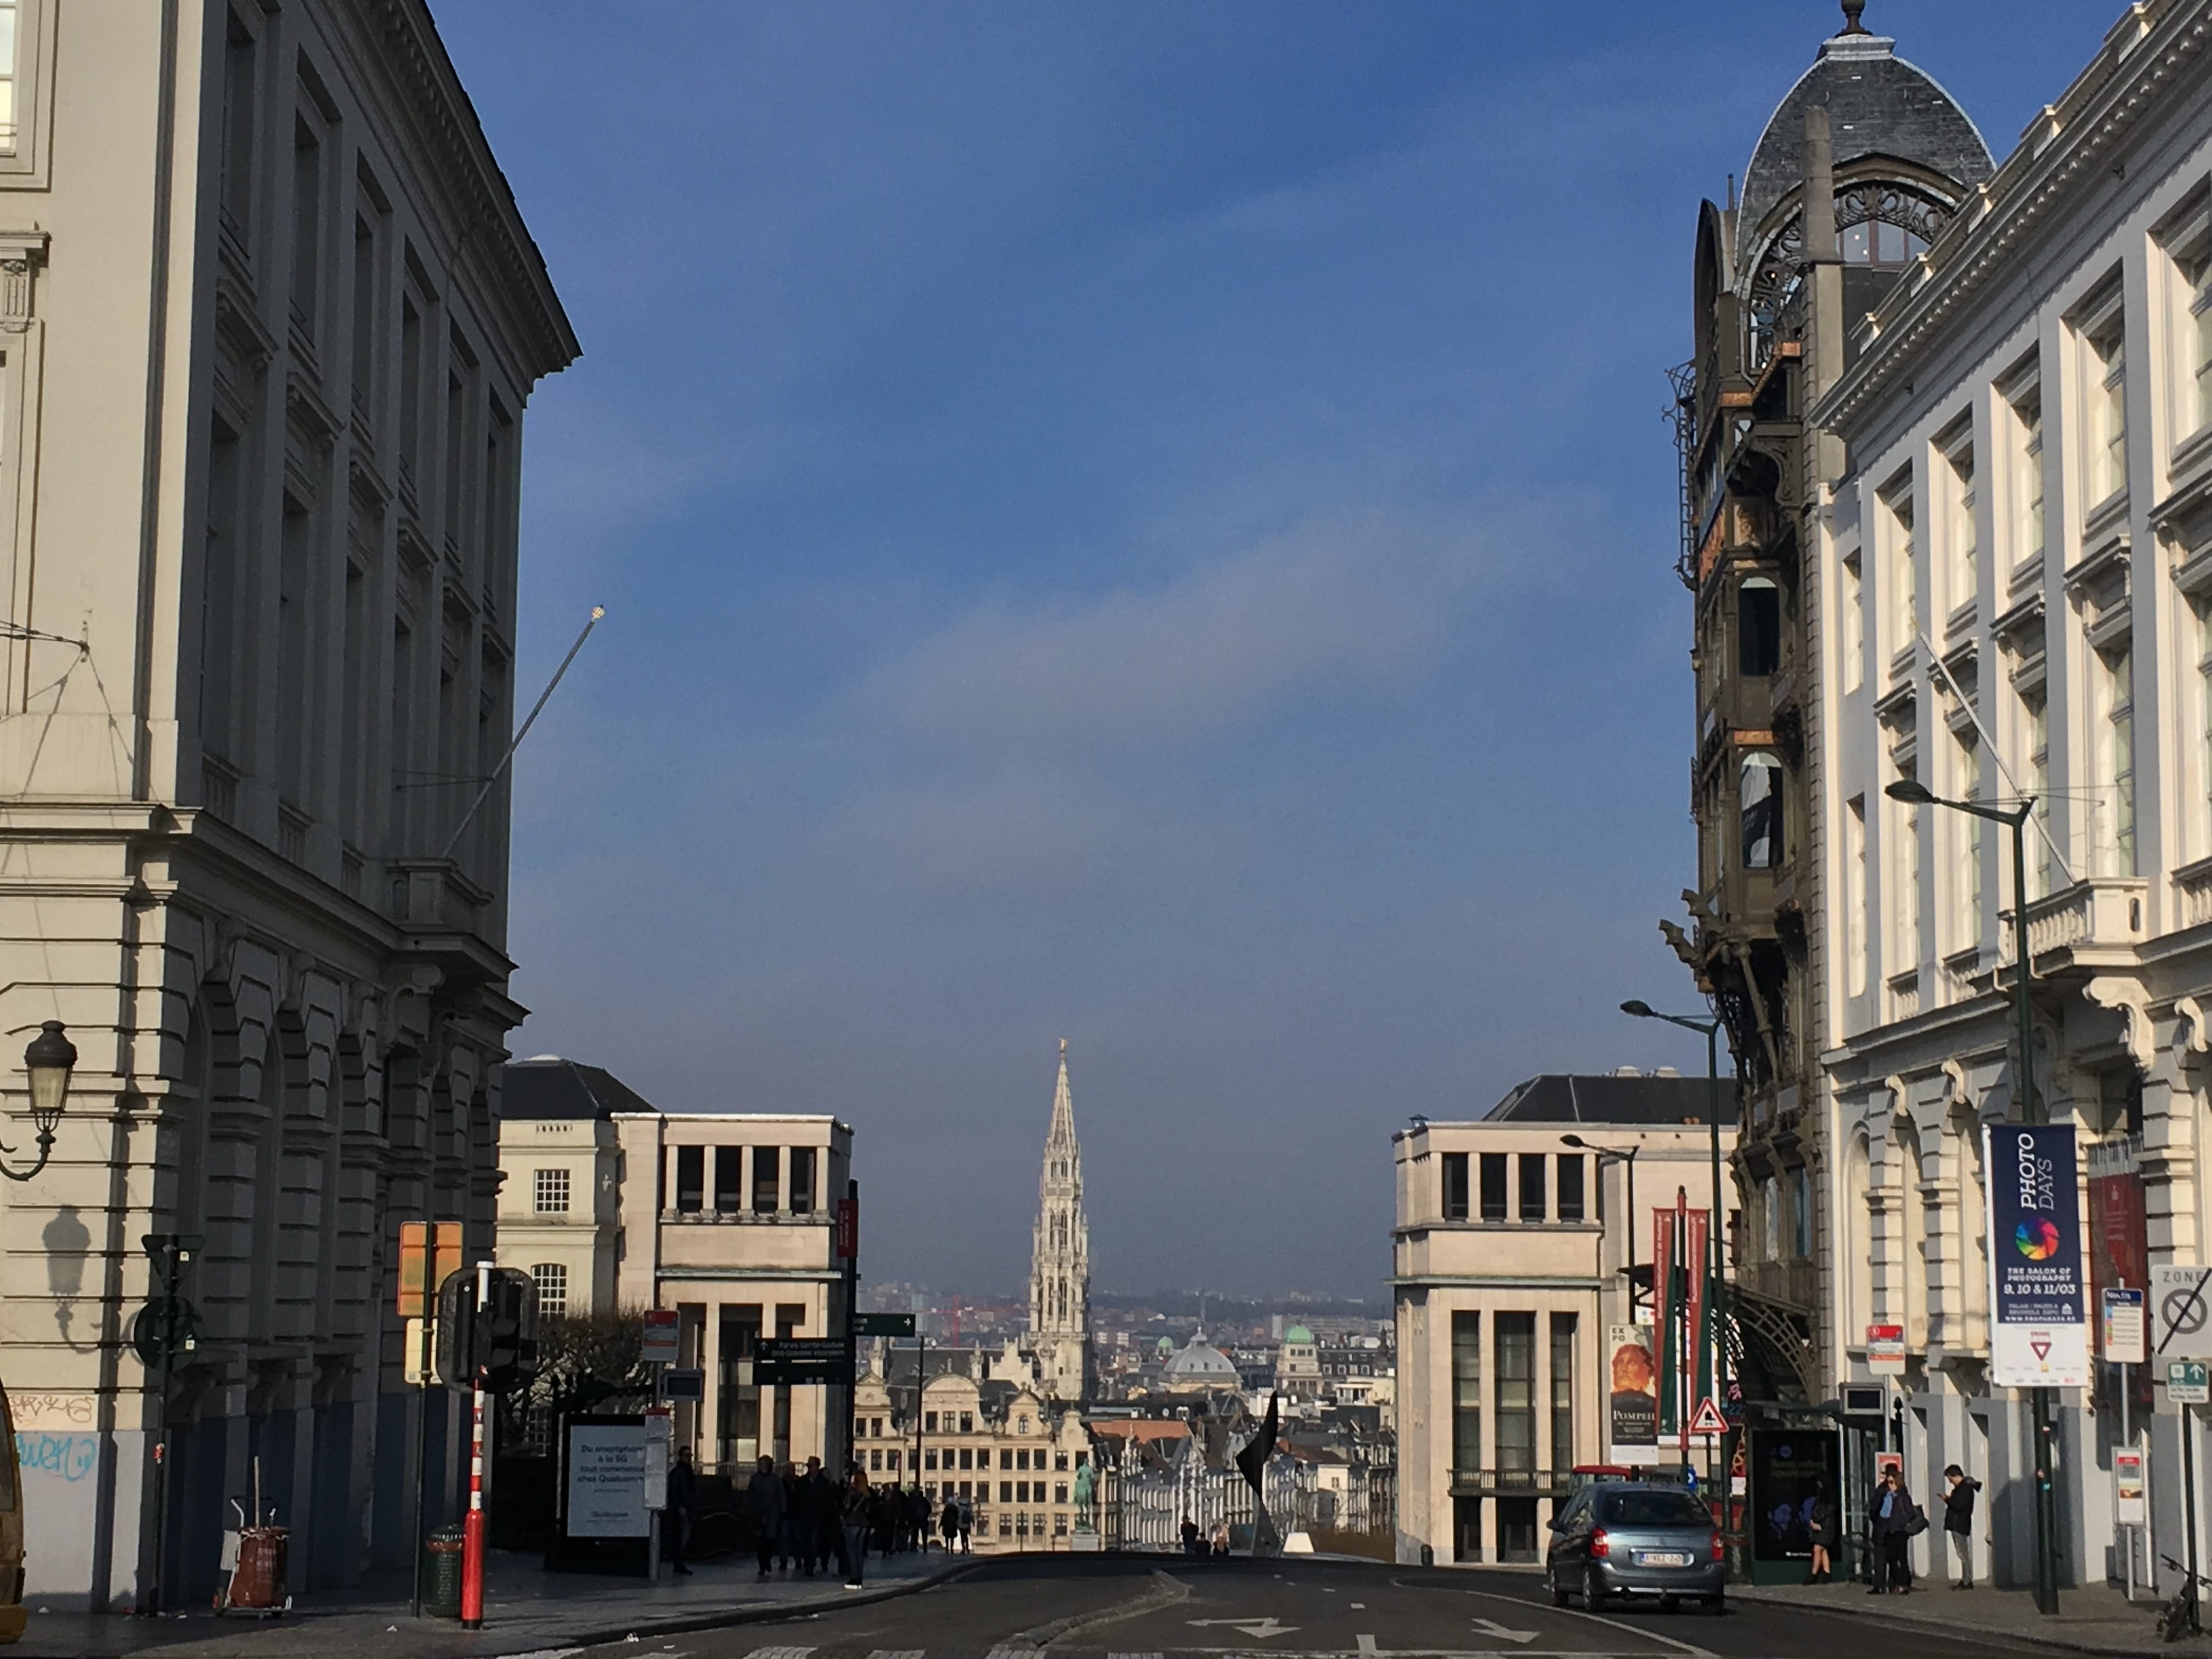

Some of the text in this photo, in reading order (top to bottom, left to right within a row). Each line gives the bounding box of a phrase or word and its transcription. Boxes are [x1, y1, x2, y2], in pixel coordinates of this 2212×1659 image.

[2018, 1133, 2037, 1210] PHOTO
[2037, 1158, 2054, 1210] DAYS
[2017, 1284, 2031, 1295] 10
[2033, 1284, 2042, 1295] &
[2044, 1283, 2076, 1295] 11/03
[2163, 1271, 2203, 1283] ZONE
